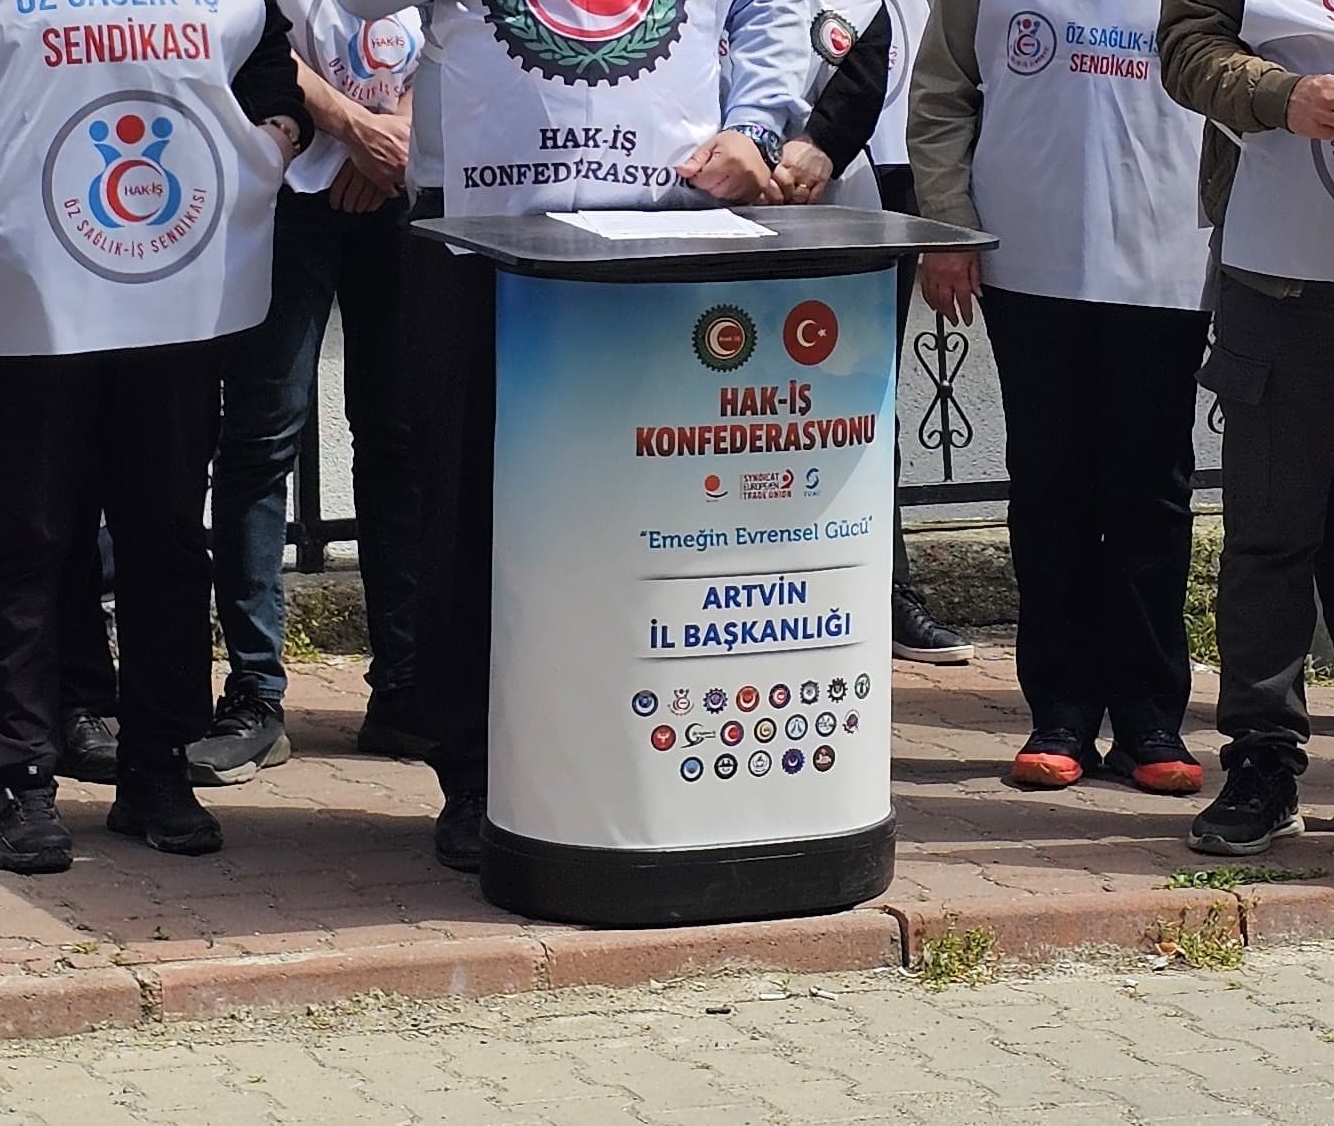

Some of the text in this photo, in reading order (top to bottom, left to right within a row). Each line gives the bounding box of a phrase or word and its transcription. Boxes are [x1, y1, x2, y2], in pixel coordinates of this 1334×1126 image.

[42, 17, 211, 67] SENDİKASI
[1066, 22, 1085, 45] ÖZ
[1070, 54, 1149, 80] SENDİKASI
[539, 124, 637, 157] HAK-İŞ
[720, 380, 812, 418] HAK-İŞ
[636, 415, 876, 457] KONFEDERASYONU
[736, 523, 818, 545] Evrensel
[702, 575, 807, 610] ARTVİN
[650, 607, 851, 652] İL BAŞKANLIĞI
